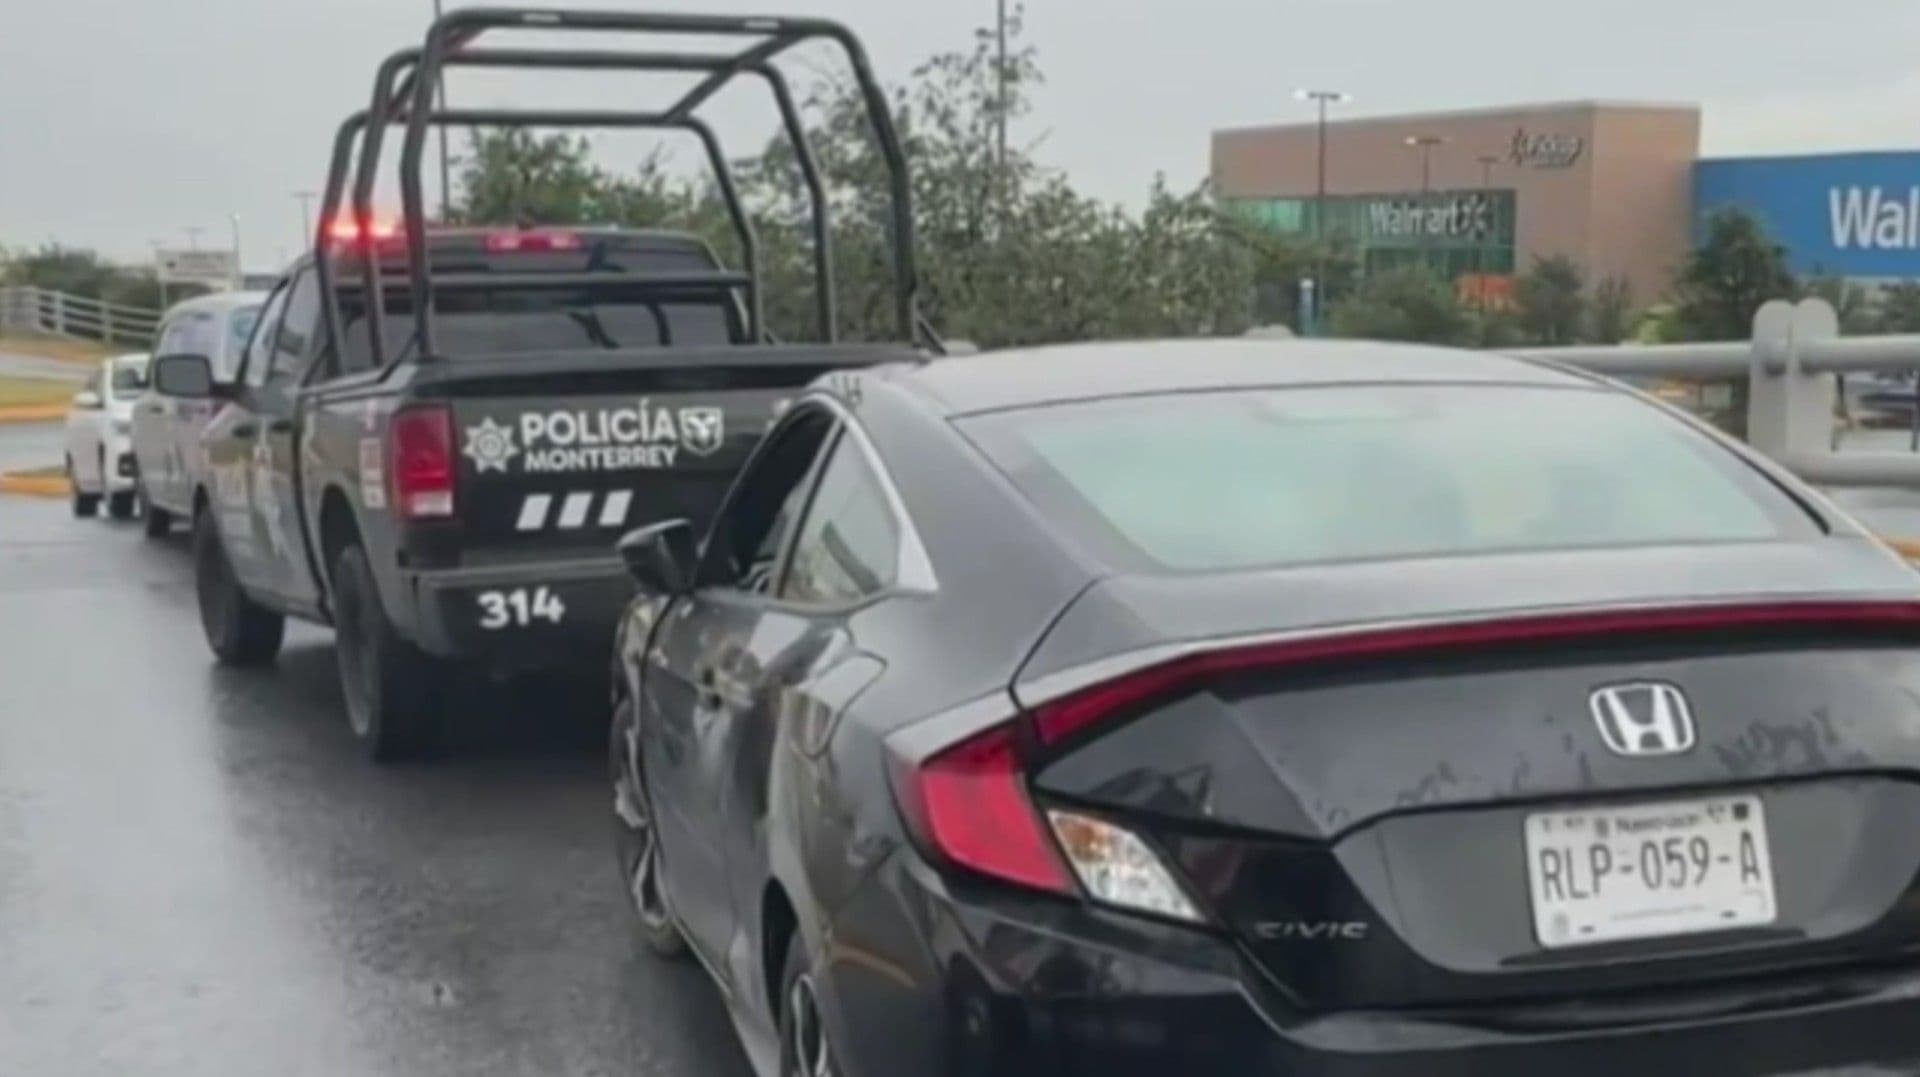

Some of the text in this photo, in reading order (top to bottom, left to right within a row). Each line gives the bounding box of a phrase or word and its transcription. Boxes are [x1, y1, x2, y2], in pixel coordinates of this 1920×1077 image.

[1370, 200, 1458, 235] Walmart
[1828, 184, 1920, 249] Wal
[520, 398, 678, 445] POLICÍA
[525, 445, 678, 473] MONTERREY
[478, 586, 566, 629] 314
[1539, 829, 1761, 901] RLP-059-A
[1254, 921, 1369, 939] CIVIC
